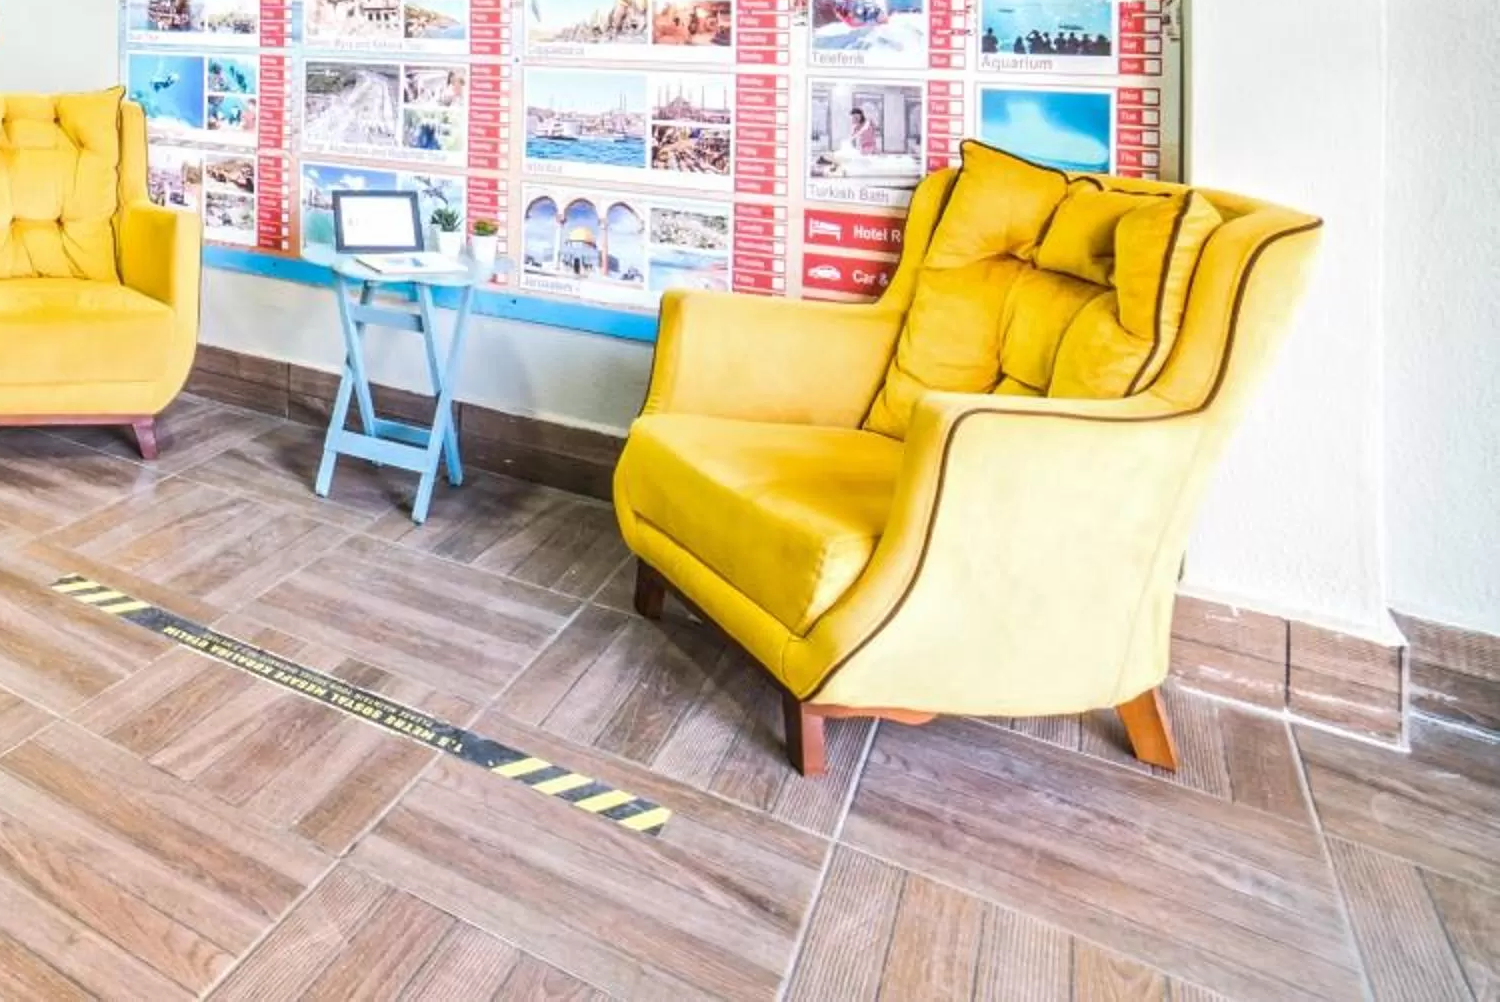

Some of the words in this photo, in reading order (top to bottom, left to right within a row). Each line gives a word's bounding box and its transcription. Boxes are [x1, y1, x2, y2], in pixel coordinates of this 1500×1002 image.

[982, 56, 1053, 70] Aquarium
[853, 225, 888, 241] Hotel
[852, 269, 876, 285] Car
[878, 272, 889, 287] &
[273, 671, 329, 696] MESAFE
[330, 693, 381, 719] SOSYAL
[384, 715, 436, 741] METRE
